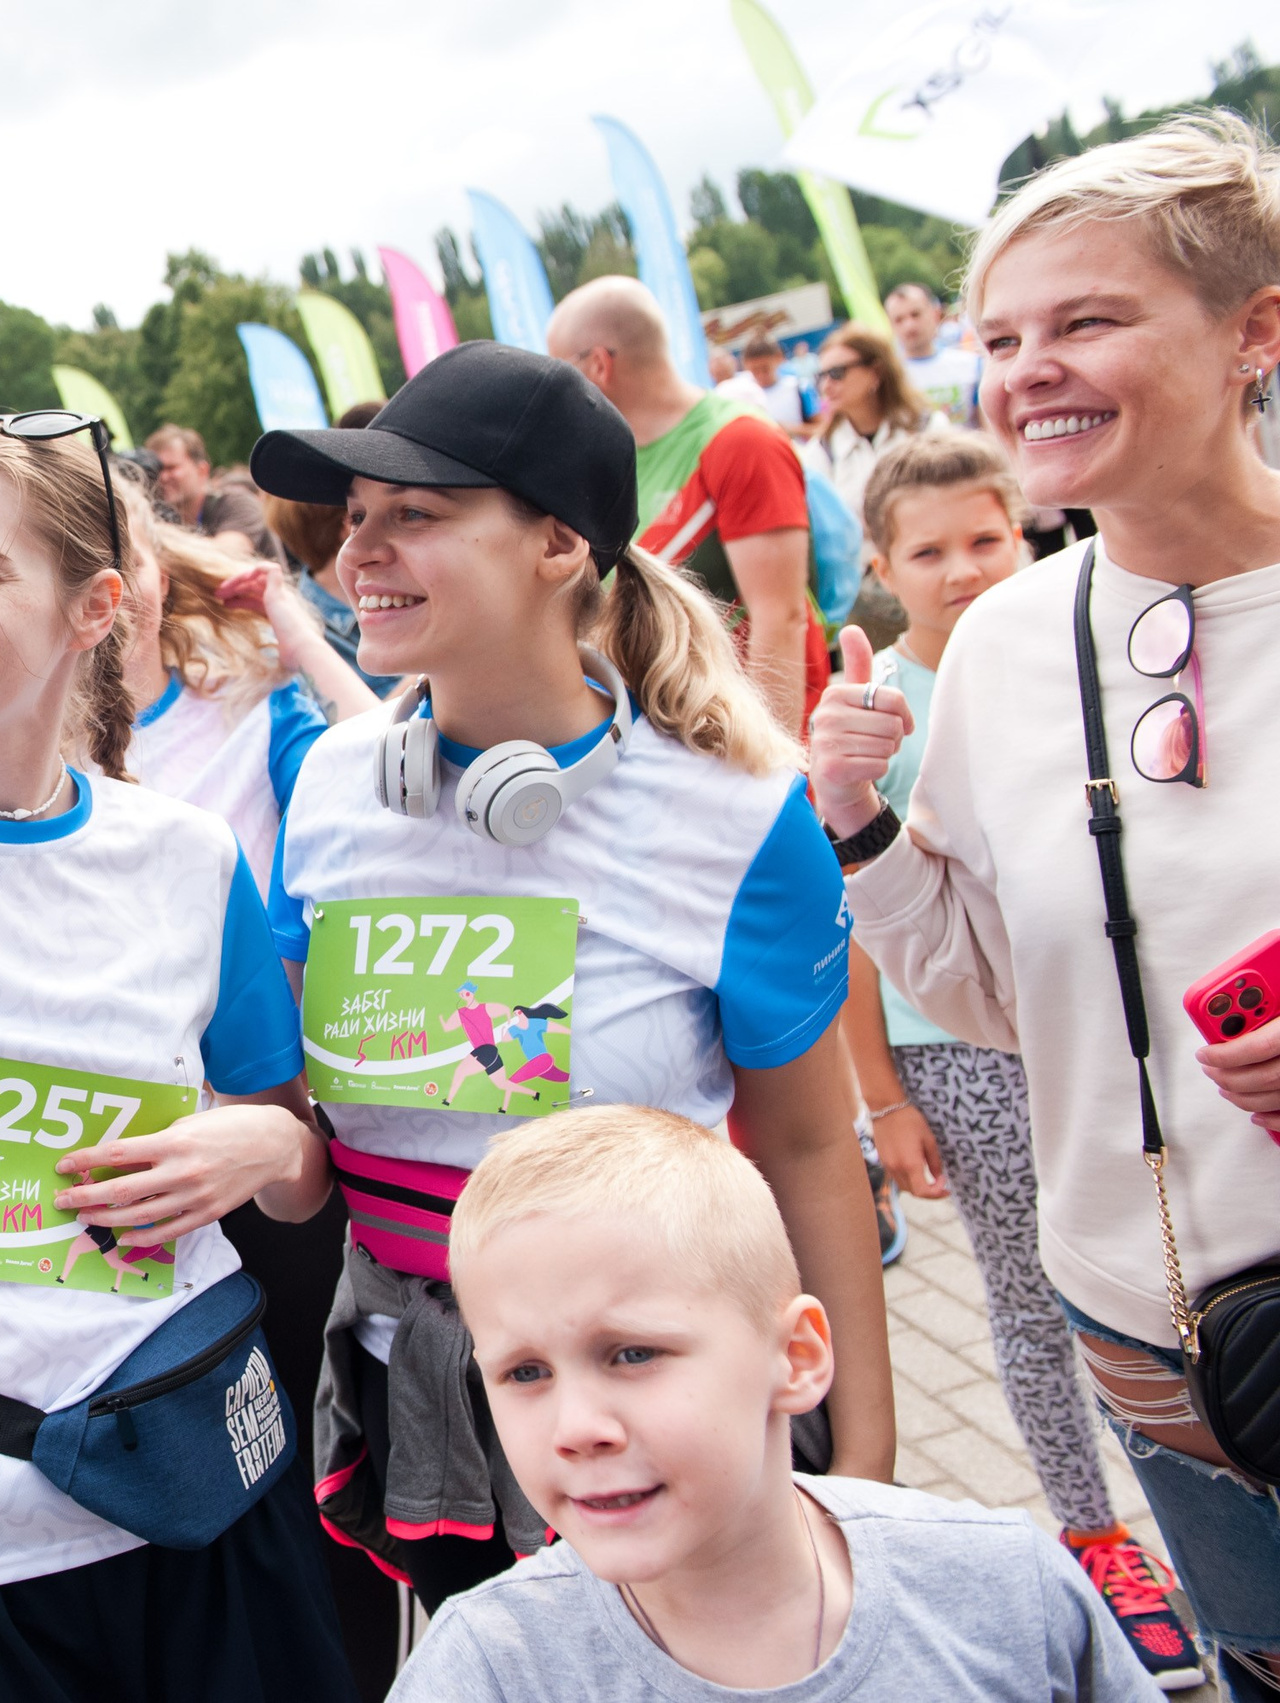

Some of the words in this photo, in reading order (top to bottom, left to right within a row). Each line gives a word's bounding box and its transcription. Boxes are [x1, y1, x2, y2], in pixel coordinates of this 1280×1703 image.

[349, 913, 515, 978] 1272
[813, 937, 846, 976] ЛИНИЯ
[340, 988, 392, 1016] ЗАБЕГ
[323, 1016, 360, 1040] РАДИ
[362, 1007, 426, 1035] ЖИЗНИ
[354, 1033, 377, 1068] 5
[226, 1402, 261, 1453] SEM
